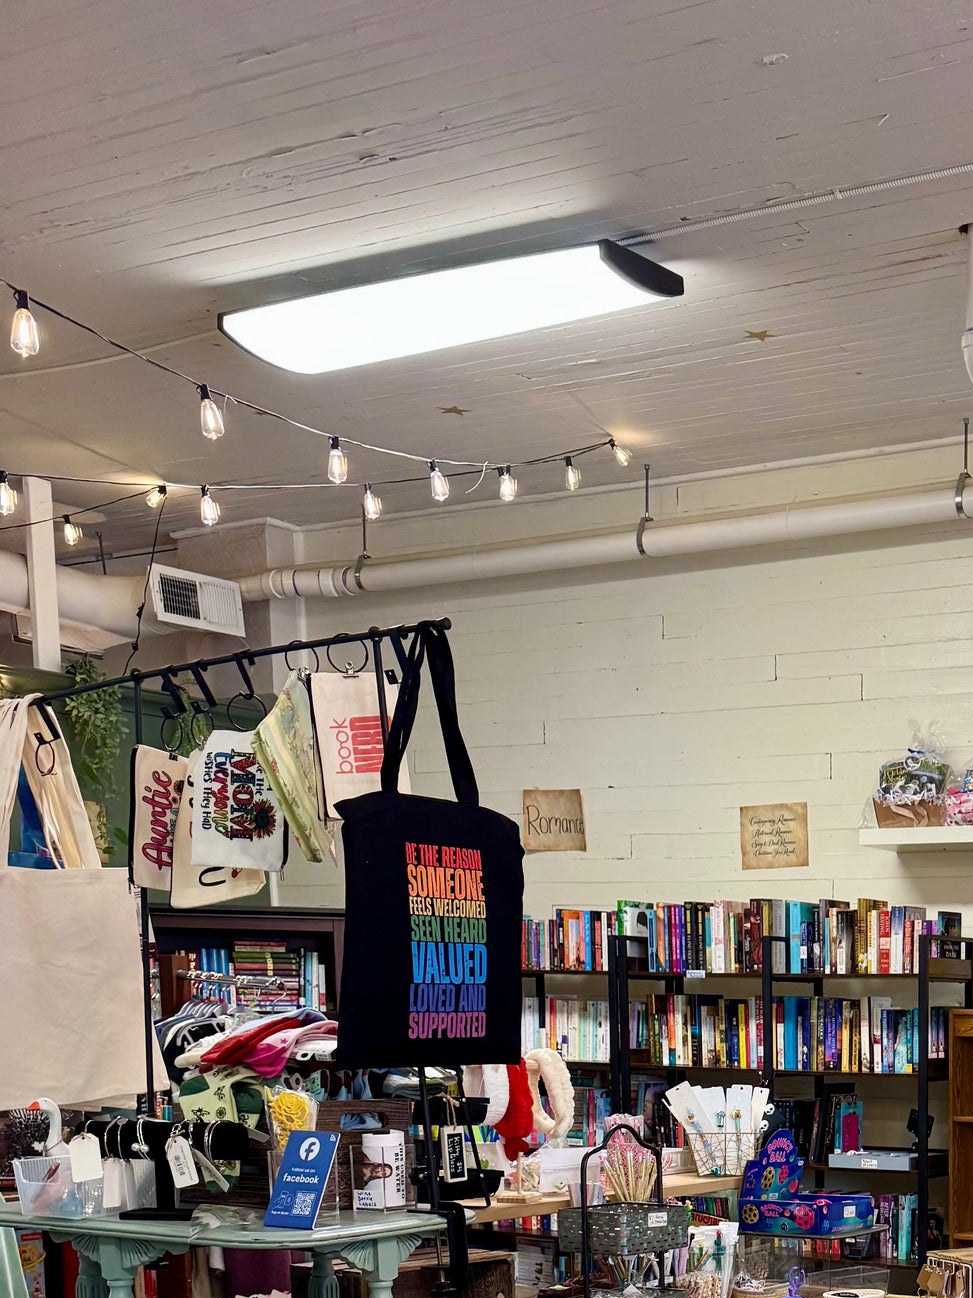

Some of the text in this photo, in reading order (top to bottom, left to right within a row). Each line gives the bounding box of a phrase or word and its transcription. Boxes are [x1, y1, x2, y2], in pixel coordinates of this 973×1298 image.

[329, 717, 354, 775] book
[212, 752, 233, 838] Everyone
[230, 748, 256, 842] MOM
[141, 770, 173, 871] Auntie
[405, 841, 482, 871] BE THE REASON
[407, 863, 486, 901] SOMEONE
[408, 895, 486, 919] FEELS WELCOMED
[410, 914, 487, 944] SEEN HEARD
[410, 941, 488, 985] VALUED
[409, 983, 487, 1012] LOVED AND
[407, 1011, 487, 1039] SUPPORTED
[767, 1137, 793, 1154] BOUNCY
[769, 1151, 787, 1163] BALL
[282, 1174, 320, 1184] facebook
